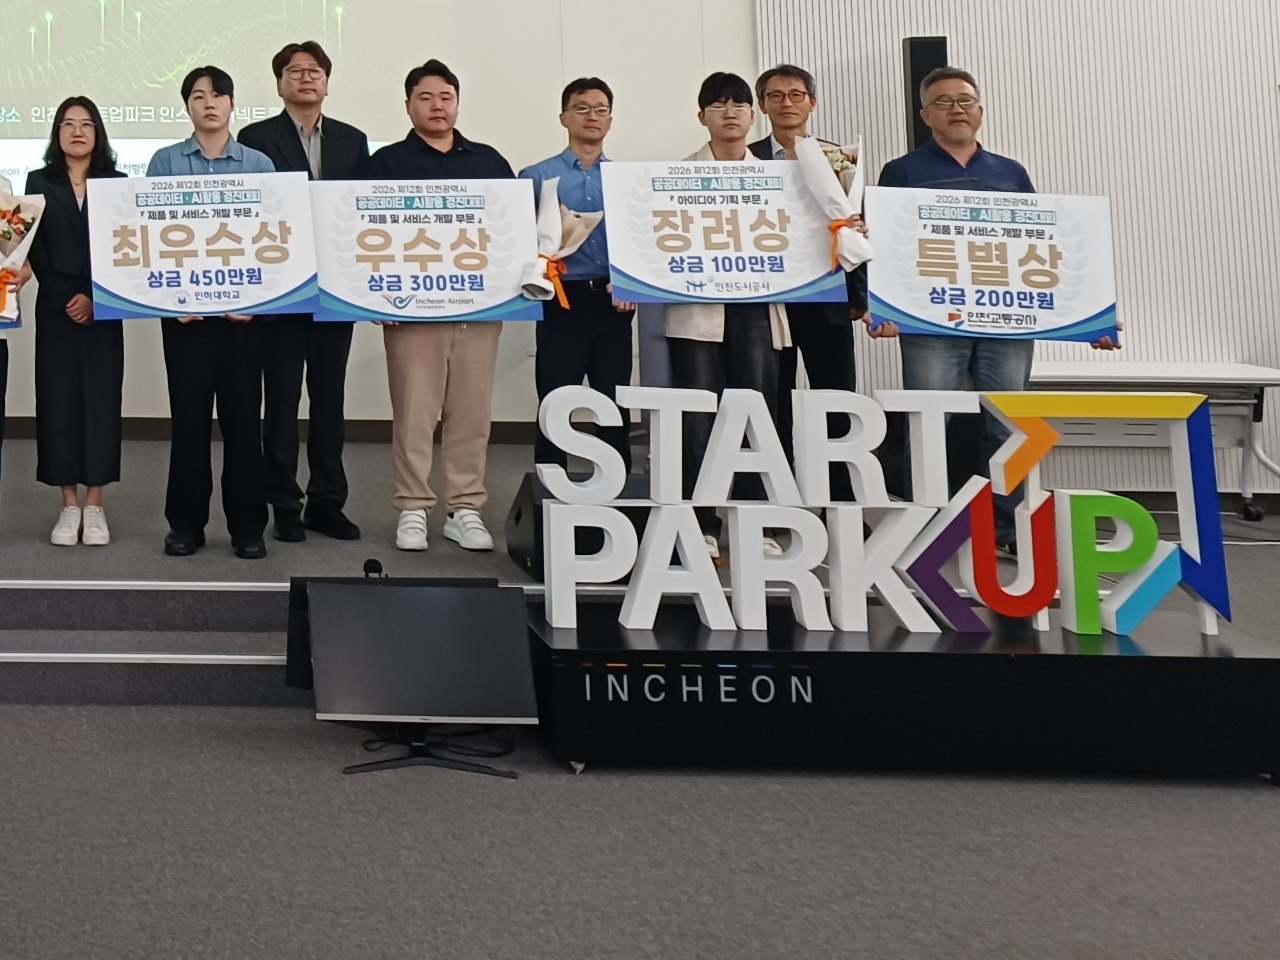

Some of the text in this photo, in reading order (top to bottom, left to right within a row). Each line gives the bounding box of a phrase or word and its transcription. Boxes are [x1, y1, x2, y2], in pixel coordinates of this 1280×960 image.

[668, 166, 692, 175] 2026
[722, 165, 765, 174] 인천광역시
[151, 182, 174, 190] 2026
[203, 179, 244, 189] 인천광역시
[372, 185, 396, 194] 2026
[426, 184, 468, 193] 인천광역시
[653, 177, 783, 190] 공공데이터 AI활용 경진대회
[137, 190, 261, 206] 공공데이터 AI활용 경진대회
[357, 196, 484, 209] 공공데이터 AI활용 경진대회
[719, 195, 739, 205] 기획
[935, 195, 960, 204] 2026
[993, 197, 1038, 207] 인천광역시
[169, 210, 179, 220] 및
[181, 209, 210, 219] 서비스
[212, 208, 231, 218] 개발
[390, 214, 399, 224] 및
[402, 214, 431, 224] 서비스
[434, 214, 453, 224] 개발
[919, 205, 1056, 225] 공공데이터 AI활용 경진대회
[651, 208, 791, 253] 장려상
[954, 225, 964, 235] 및
[967, 226, 999, 237] 서비스
[1001, 228, 1022, 238] 개발
[112, 220, 291, 268] 최우수상
[356, 227, 491, 272] 우수상
[668, 255, 785, 273] 상금 100만원
[916, 237, 1062, 290] 특별상
[147, 267, 263, 288] 상금 450만원
[367, 274, 485, 291] 상금 300만원
[195, 290, 240, 300] 인하대학교
[448, 298, 474, 306] Airport
[929, 287, 1055, 310] 상금 200만원
[967, 311, 1038, 326] 인천교통공사
[536, 385, 982, 507] START
[542, 476, 1160, 636] PARK UP
[584, 672, 814, 704] INCHEON
